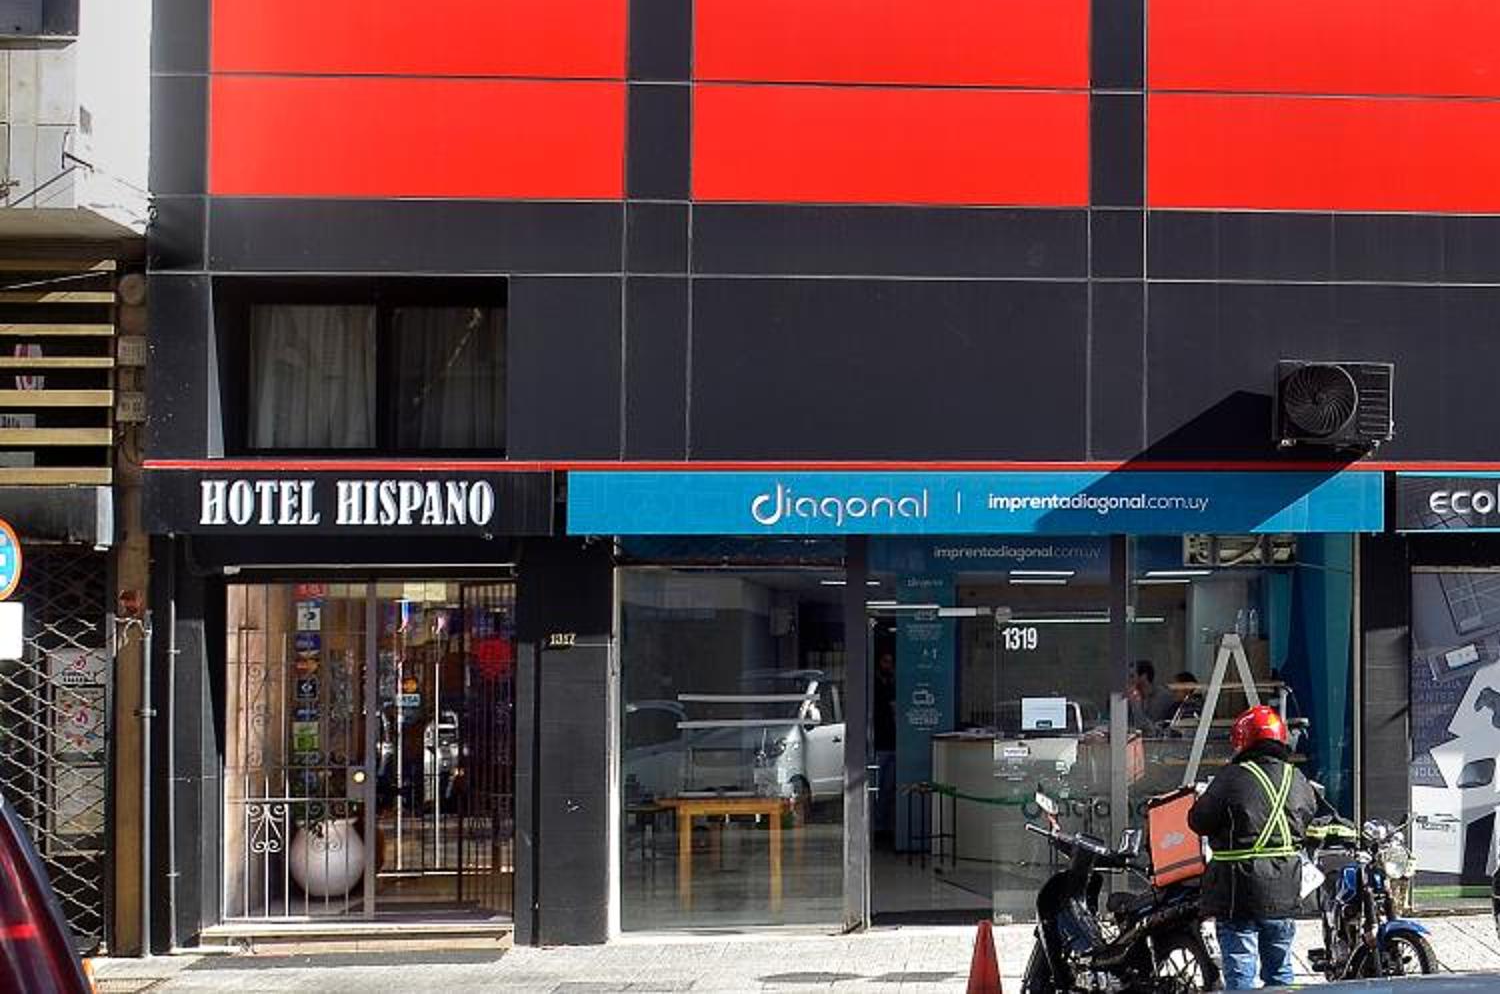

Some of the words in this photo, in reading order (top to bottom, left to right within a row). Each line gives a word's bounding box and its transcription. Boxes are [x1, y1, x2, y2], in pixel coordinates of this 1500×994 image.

[200, 479, 320, 525] HOTEL
[336, 478, 495, 526] HISPANO
[752, 483, 929, 526] diagonal
[988, 493, 1209, 514] imprentadiagonal.com.uy
[1002, 627, 1038, 650] 1319
